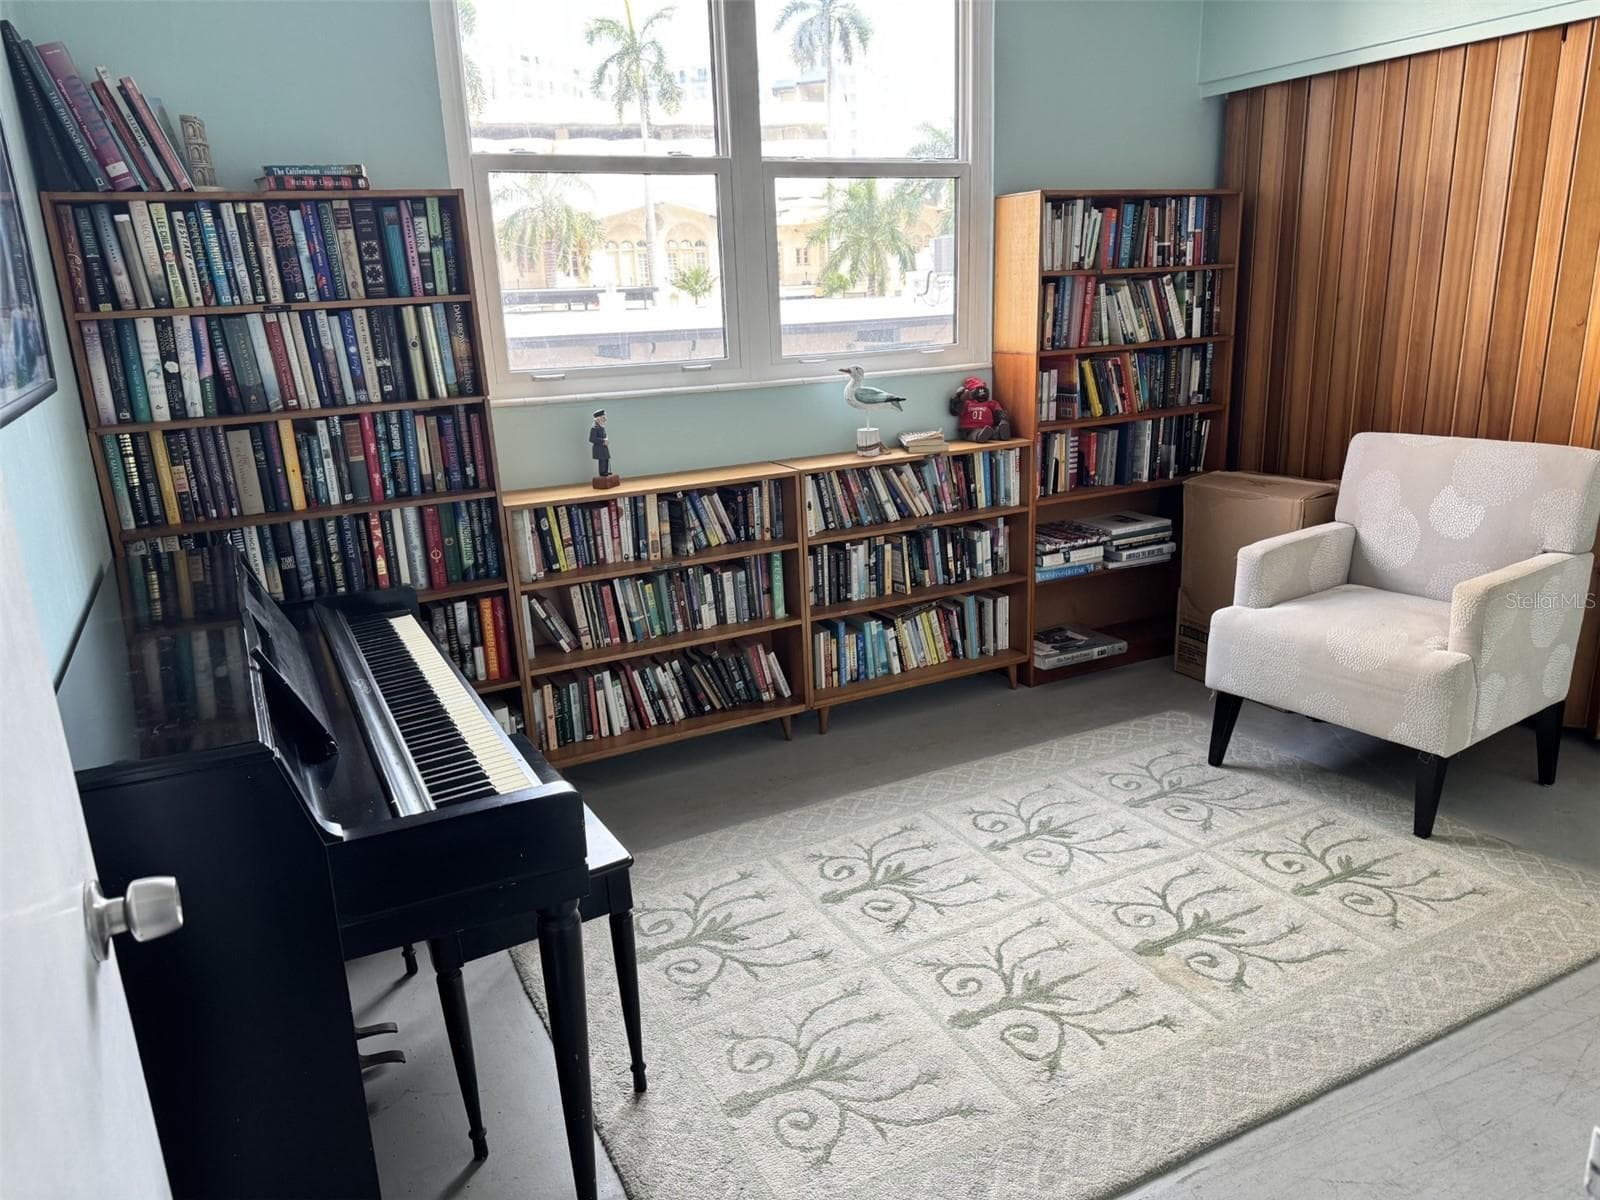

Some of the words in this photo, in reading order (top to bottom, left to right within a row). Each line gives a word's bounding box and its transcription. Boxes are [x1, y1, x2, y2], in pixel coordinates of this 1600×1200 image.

[48, 90, 61, 107] THE
[57, 107, 91, 163] PHOTOGRAPHS
[155, 216, 166, 230] LEE
[200, 206, 215, 232] JANET
[268, 206, 285, 248] COULTER
[278, 204, 294, 247] CATHERINE
[159, 230, 171, 250] CHILD
[176, 217, 193, 261] BESTIARY
[414, 220, 425, 249] MARK
[206, 232, 224, 276] EVANOVICH
[246, 241, 258, 266] Richard
[281, 260, 293, 283] OUT
[288, 256, 302, 284] BLOW
[369, 309, 380, 333] VINCE
[452, 304, 462, 321] DAN
[373, 333, 384, 357] FLYNN
[455, 322, 468, 350] BROWN
[216, 346, 227, 367] NEVER
[972, 410, 983, 420] 01
[118, 432, 134, 457] STEVE
[390, 423, 401, 450] SANDFORD
[109, 458, 122, 490] MALLERY
[125, 455, 140, 486] MARTINI
[314, 466, 325, 483] SAY
[146, 482, 156, 496] STEVE
[149, 496, 160, 516] MARTINI
[344, 530, 355, 558] PICOULT
[460, 519, 473, 561] VINDICATION
[251, 553, 261, 576] HARRY
[773, 554, 782, 586] TRUST
[482, 607, 495, 646] PROCESSED
[486, 646, 497, 672] CHEESE
